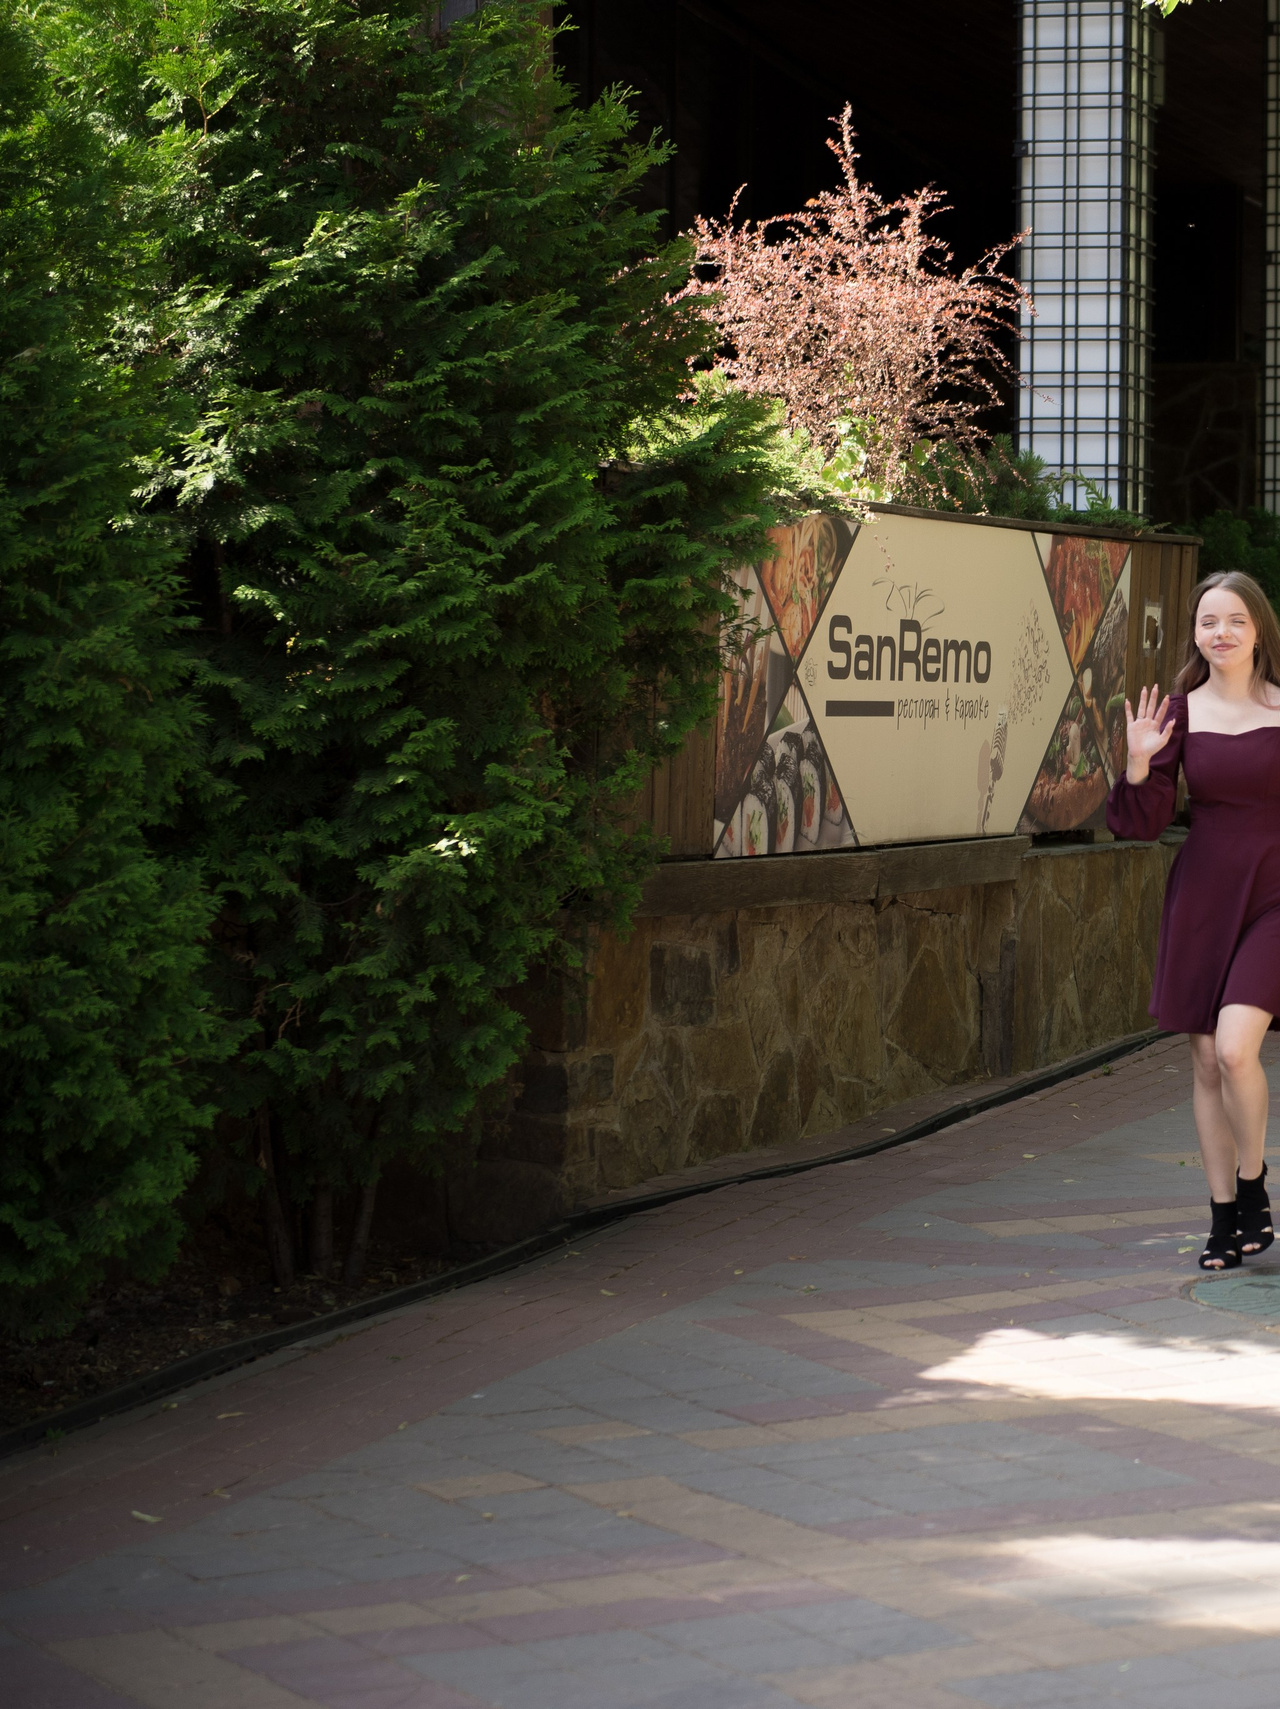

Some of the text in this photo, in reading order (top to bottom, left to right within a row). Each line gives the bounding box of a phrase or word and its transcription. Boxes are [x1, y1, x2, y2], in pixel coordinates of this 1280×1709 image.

[827, 614, 992, 684] SanRemo
[897, 698, 940, 730] ресторан
[944, 688, 950, 721] &
